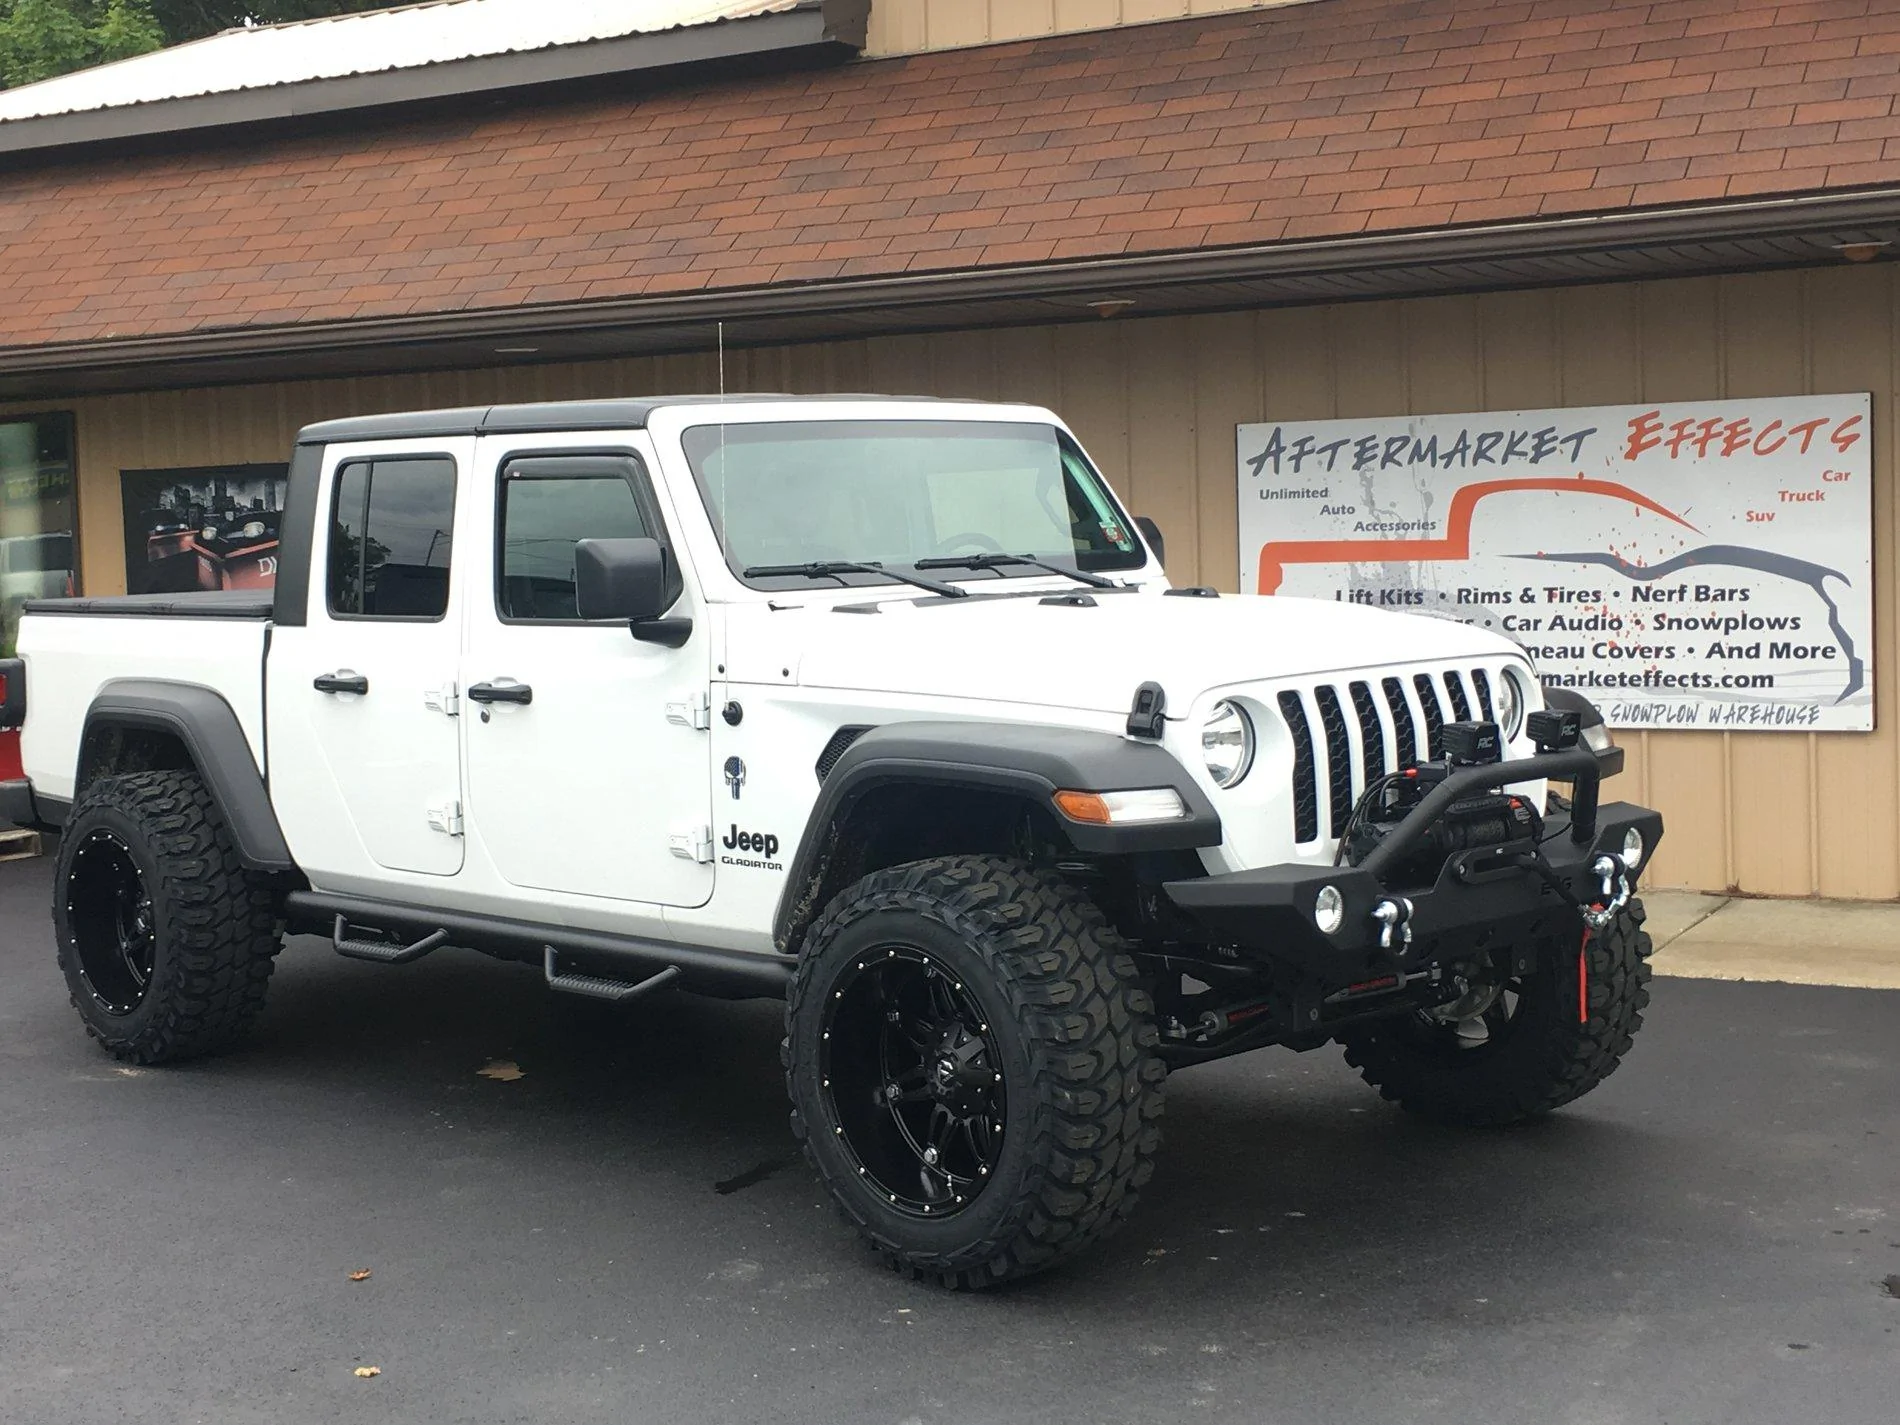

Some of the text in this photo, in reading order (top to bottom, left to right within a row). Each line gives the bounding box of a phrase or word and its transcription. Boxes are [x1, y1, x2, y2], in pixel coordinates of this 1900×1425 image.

[1246, 410, 1863, 477] AFTERMARKET EFFECTS
[1822, 469, 1851, 482] Car
[1259, 487, 1329, 500] Unlimited
[1778, 489, 1826, 502] Truck
[1320, 504, 1356, 516] Auto
[1746, 510, 1776, 522] Suv
[1353, 519, 1437, 532] Accessories
[1380, 588, 1424, 605] Kits
[1457, 587, 1512, 604] Rims
[1519, 587, 1536, 604] &
[1543, 586, 1602, 604] Tires
[1631, 584, 1688, 602] Nerf
[1694, 584, 1750, 602] Bars
[1502, 613, 1802, 635] Car Audio Snowplows
[1526, 642, 1837, 659] neau Covers And More
[1540, 669, 1775, 688] marketeffects.com
[1610, 703, 1700, 723] SNOWPLOW
[1709, 702, 1821, 724] WAREHOUSE
[722, 823, 779, 859] Jeep
[721, 855, 783, 871] GLADIATOR
